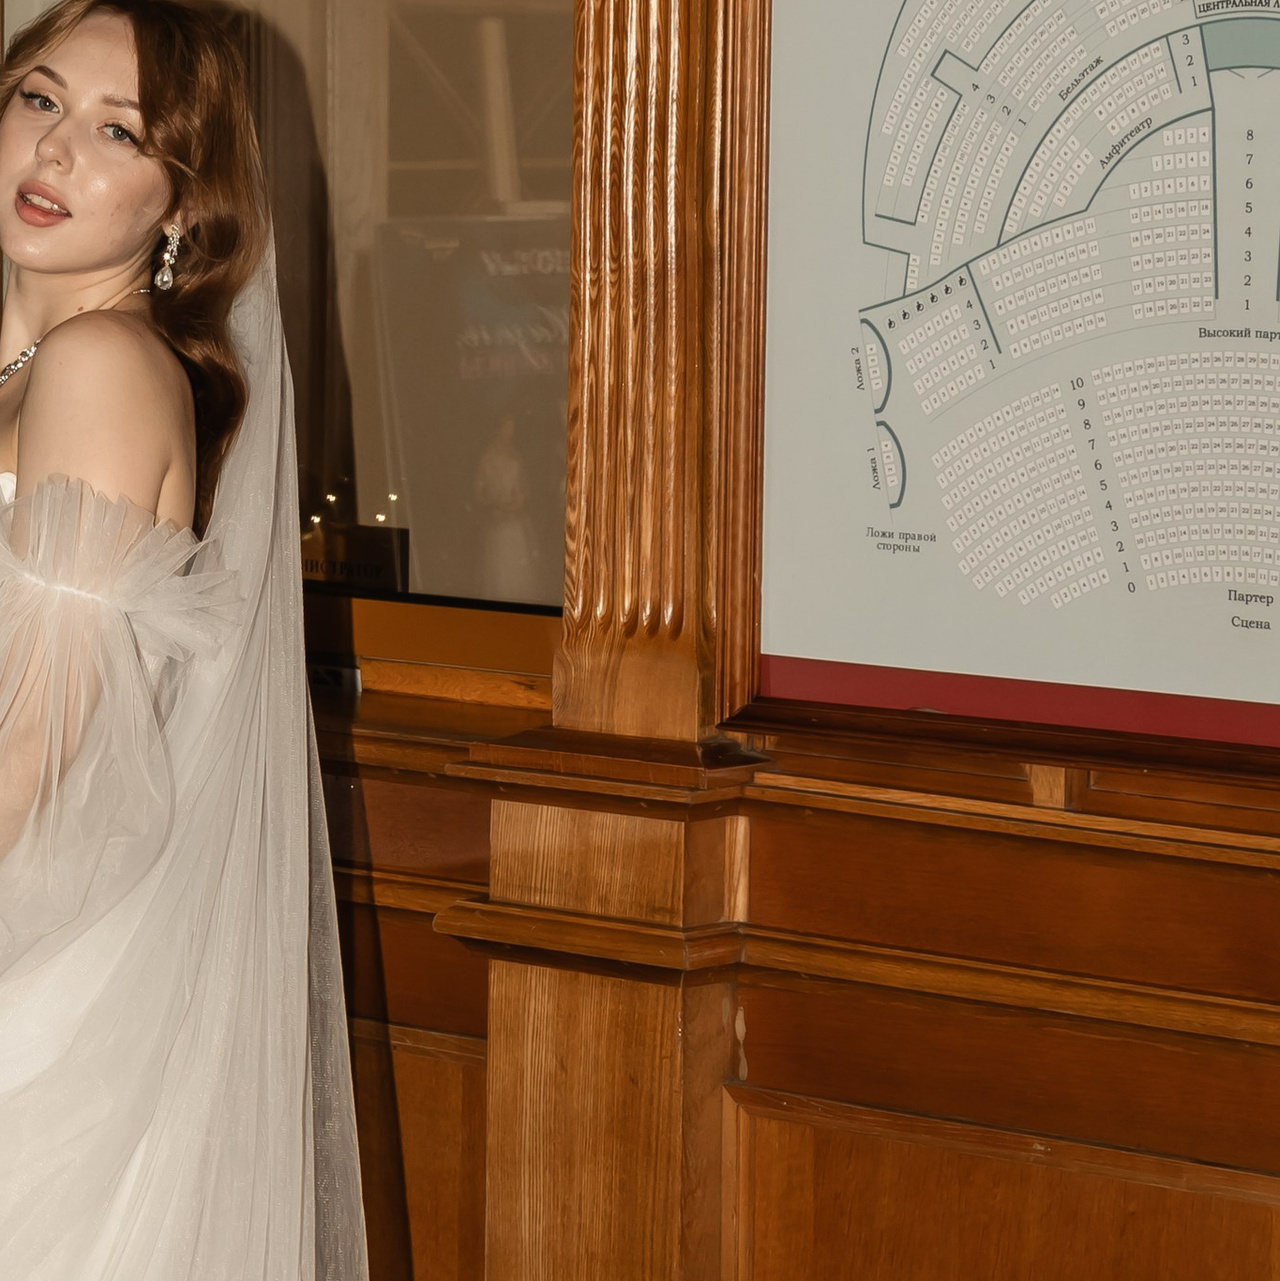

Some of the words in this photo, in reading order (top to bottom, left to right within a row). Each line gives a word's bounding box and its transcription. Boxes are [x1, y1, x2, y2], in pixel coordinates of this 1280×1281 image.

[1182, 34, 1189, 45] 3
[1186, 55, 1194, 66] 2
[1058, 56, 1104, 101] Бельэтаж
[1192, 76, 1197, 86] 1
[1247, 130, 1254, 141] 8
[1099, 117, 1153, 169] Амфитеатр
[1246, 154, 1253, 164] 7
[1246, 178, 1253, 189] 6
[1246, 202, 1252, 213] 5
[1245, 227, 1251, 237] 4
[1244, 251, 1251, 262] 3
[1244, 275, 1251, 286] 2
[967, 300, 972, 309] 4
[1246, 299, 1249, 310] 1
[973, 320, 981, 330] 3
[1199, 328, 1251, 338] Высокий
[981, 339, 988, 350] 2
[851, 347, 859, 355] 2
[989, 360, 995, 369] 1
[854, 358, 865, 391] Ложа
[1071, 377, 1084, 390] 10
[1078, 399, 1085, 410] 9
[1083, 419, 1091, 430] 8
[1088, 439, 1095, 450] 7
[1095, 459, 1102, 470] 6
[870, 457, 881, 491] Ложа
[1100, 480, 1107, 491] 5
[1106, 501, 1112, 510] 4
[1111, 521, 1118, 531] 3
[866, 527, 894, 539] Ложи
[898, 532, 937, 543] правой
[876, 542, 920, 554] стороны
[1116, 541, 1124, 552] 2
[1123, 562, 1129, 572] 1
[1128, 582, 1135, 593] 0
[1228, 590, 1274, 606] Партер
[1231, 616, 1271, 630] Сцена
